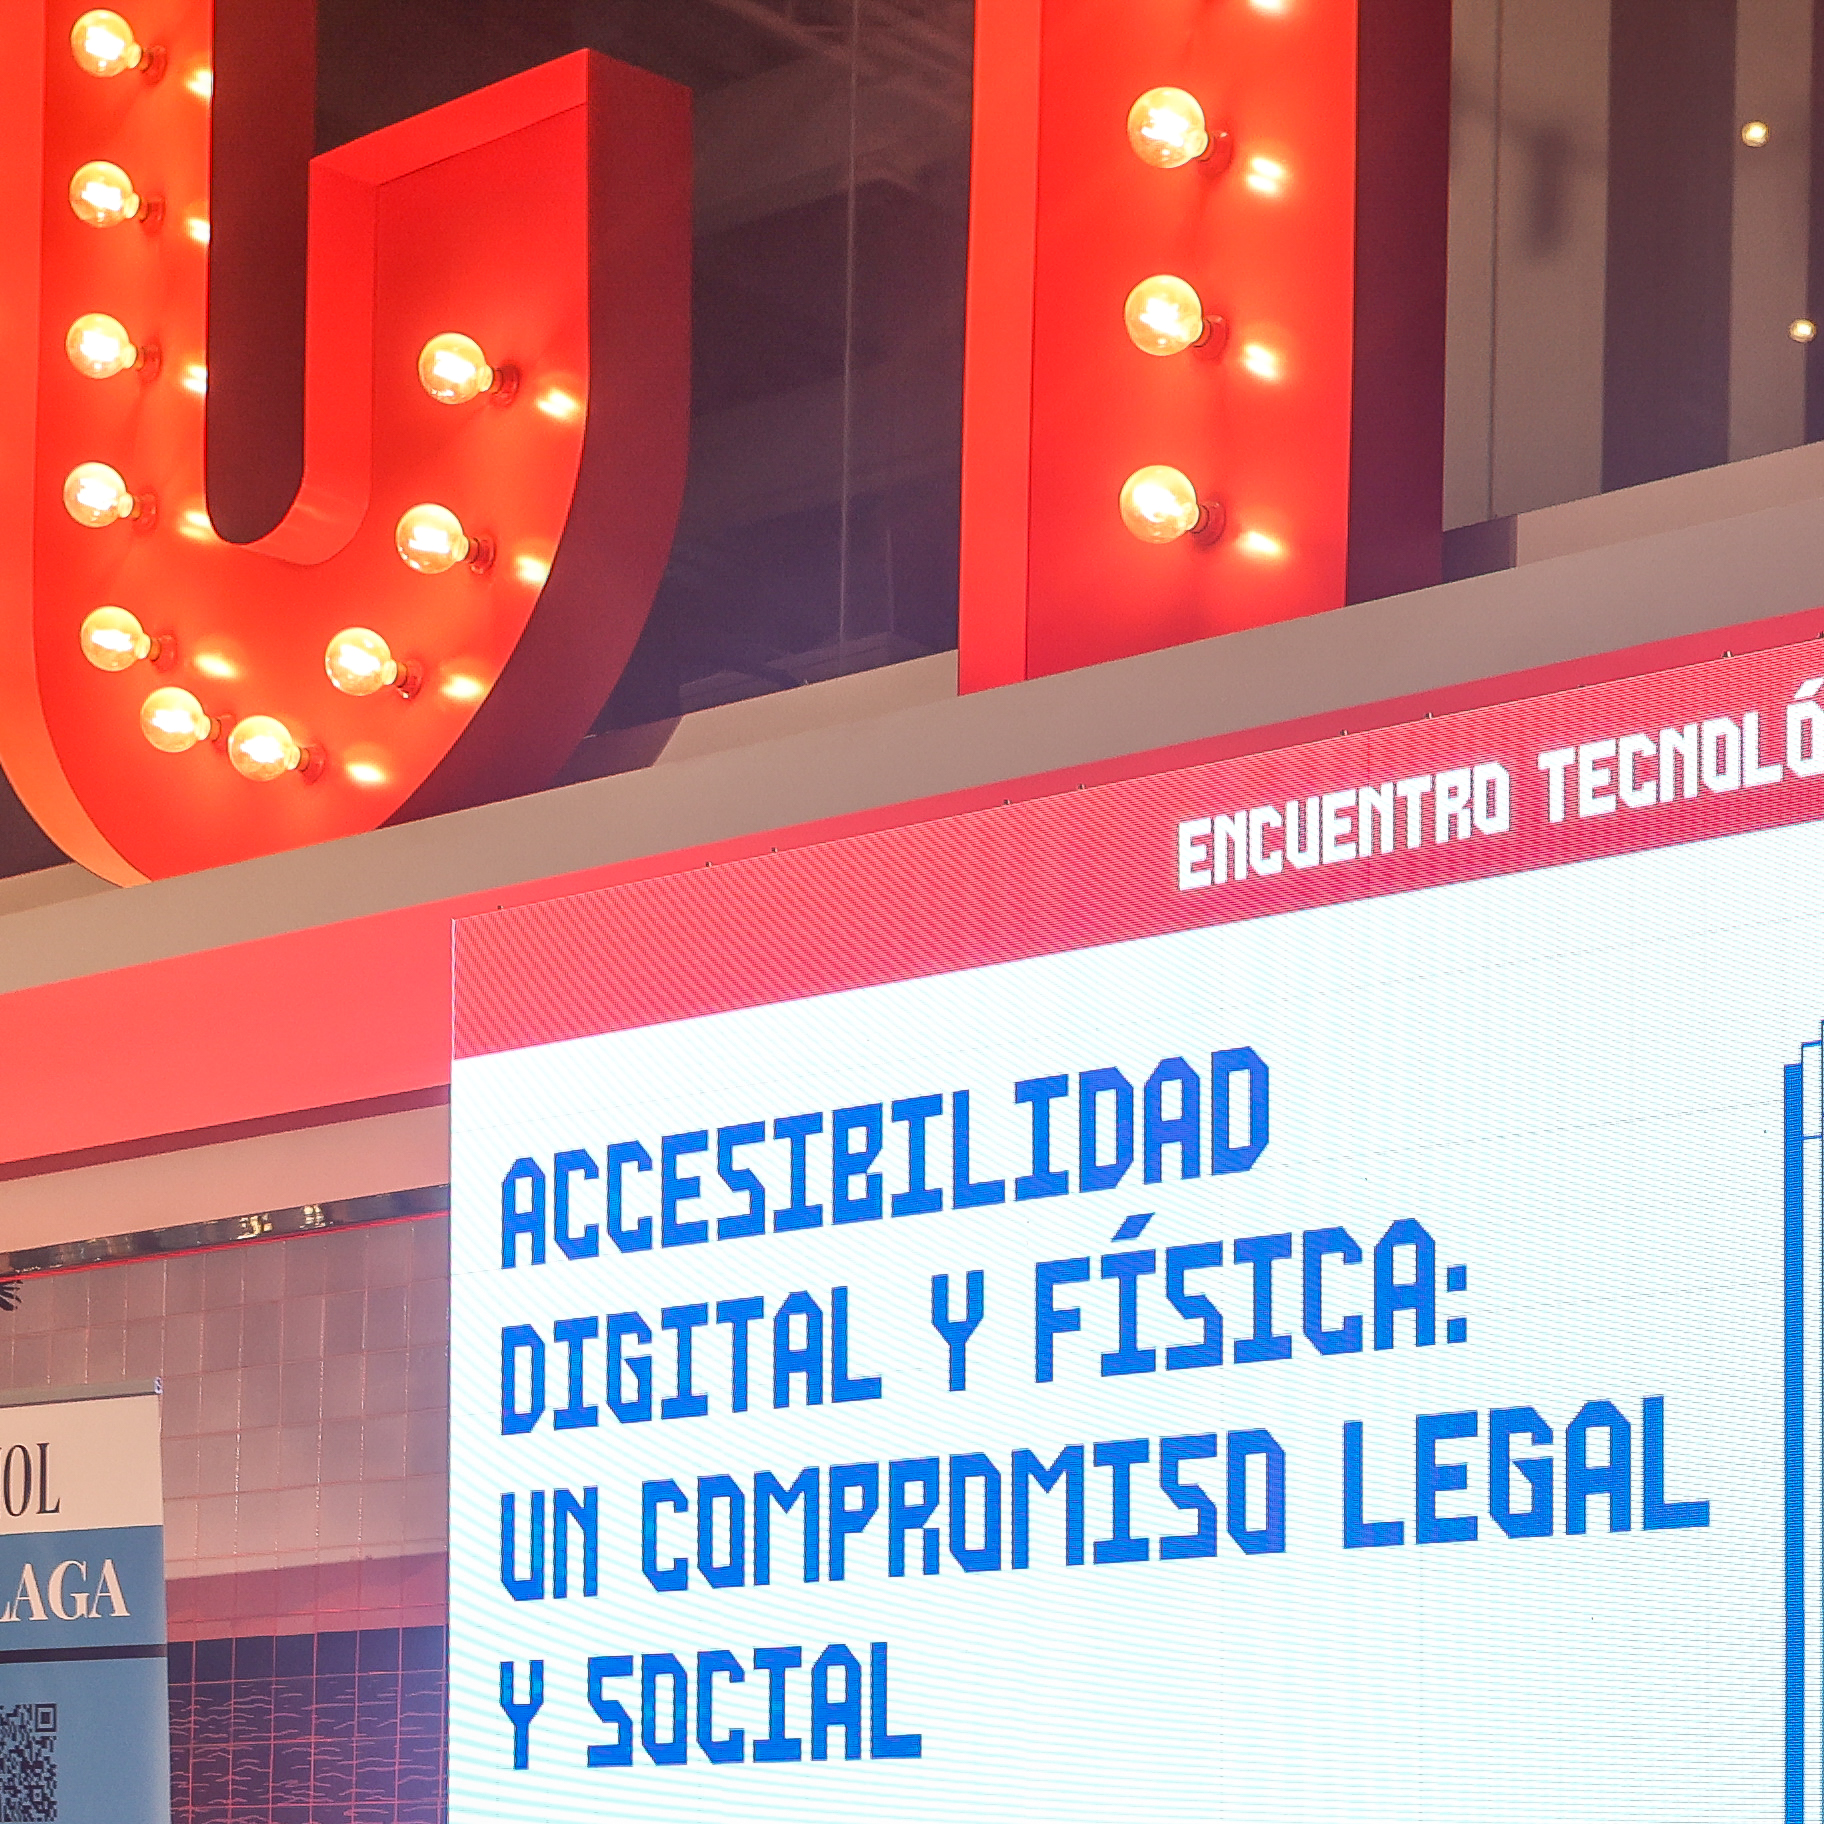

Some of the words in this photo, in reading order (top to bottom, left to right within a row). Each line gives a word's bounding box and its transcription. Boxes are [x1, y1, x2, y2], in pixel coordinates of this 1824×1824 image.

[1179, 760, 1509, 891] ENCUENTRO
[501, 1046, 1269, 1268] ACCESIBILIDAD
[501, 1288, 884, 1435] DIGITAL
[930, 1272, 984, 1391] Y
[1036, 1214, 1466, 1384] FÍSICA:
[499, 1484, 596, 1600] UN
[641, 1430, 1286, 1590] COMPROMISO
[1342, 1395, 1710, 1547] LEGAL
[499, 1660, 544, 1770] Y
[587, 1641, 922, 1768] SOCIAL
